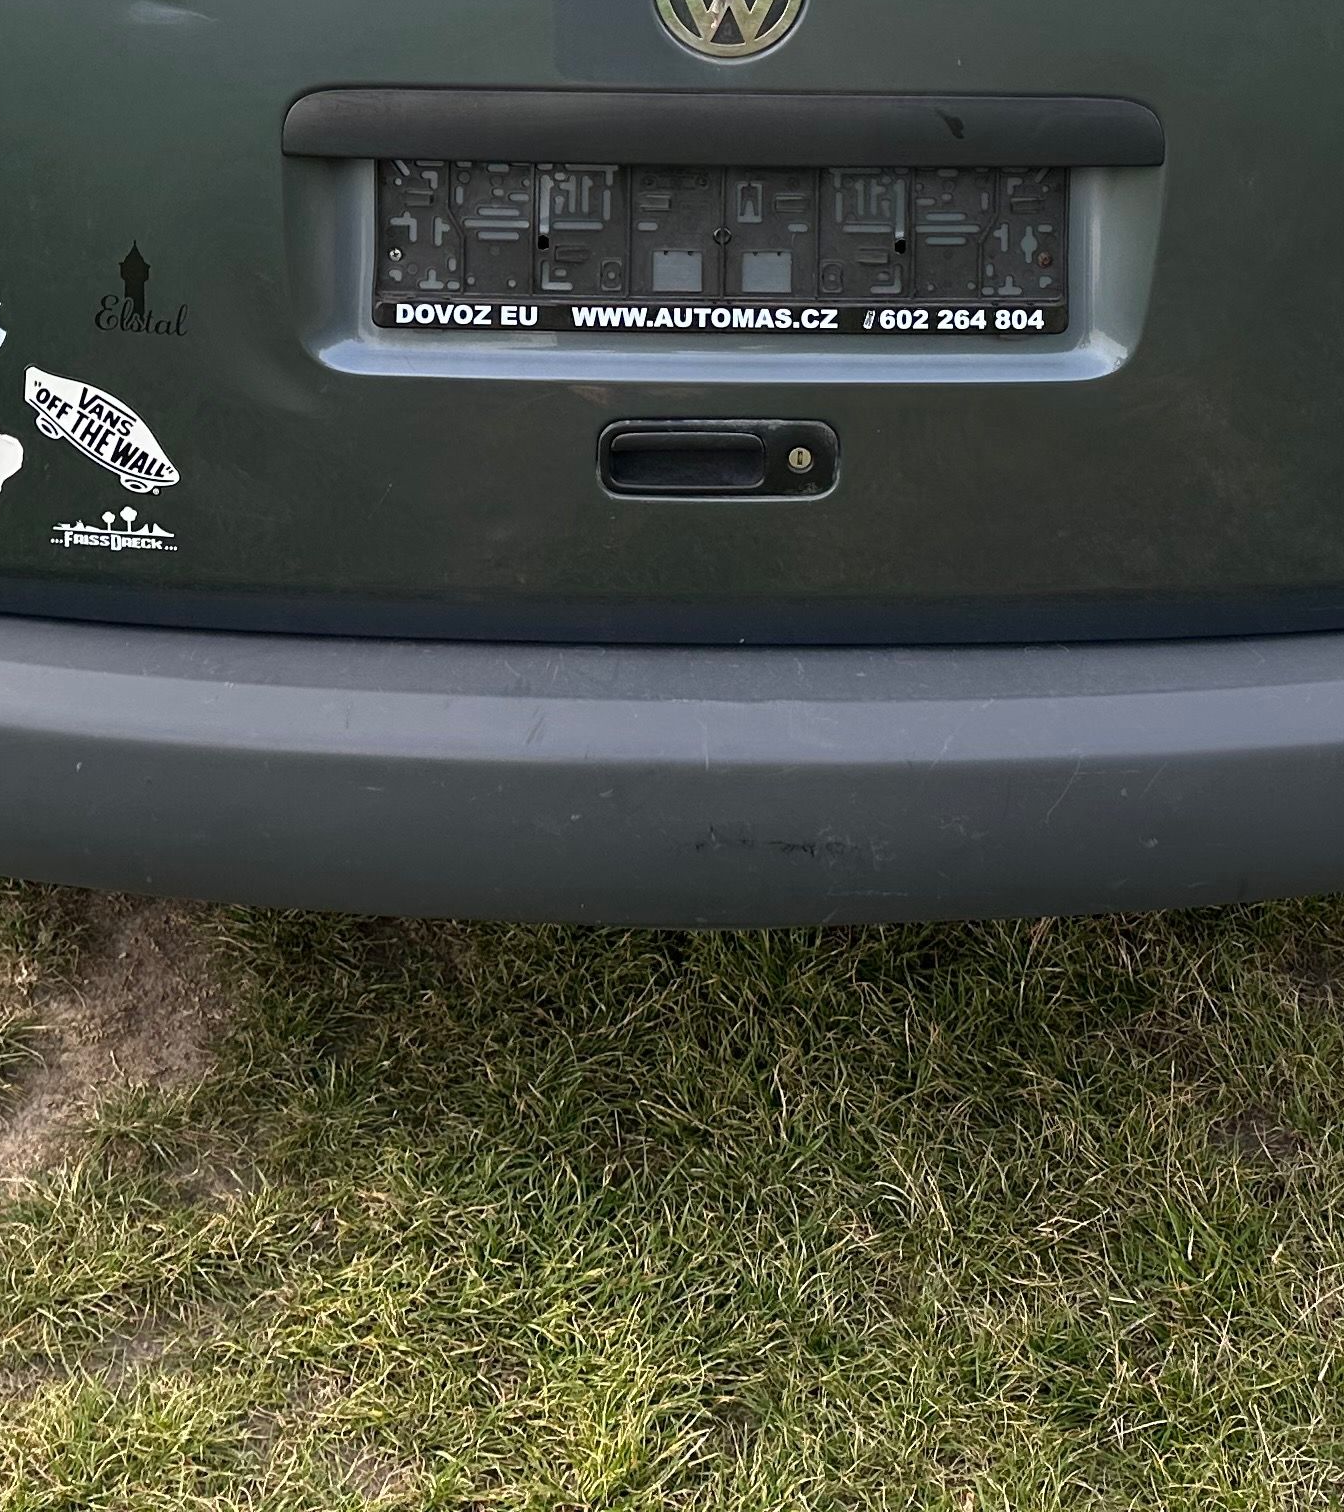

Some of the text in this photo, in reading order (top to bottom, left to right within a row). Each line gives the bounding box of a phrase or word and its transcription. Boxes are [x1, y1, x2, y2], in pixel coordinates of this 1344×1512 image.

[94, 294, 189, 337] Elstal
[395, 303, 1045, 330] DOVOZ EU WWW.AUTOMAS.CZ 602 264 804
[71, 409, 116, 457] THE
[78, 387, 137, 437] VANS
